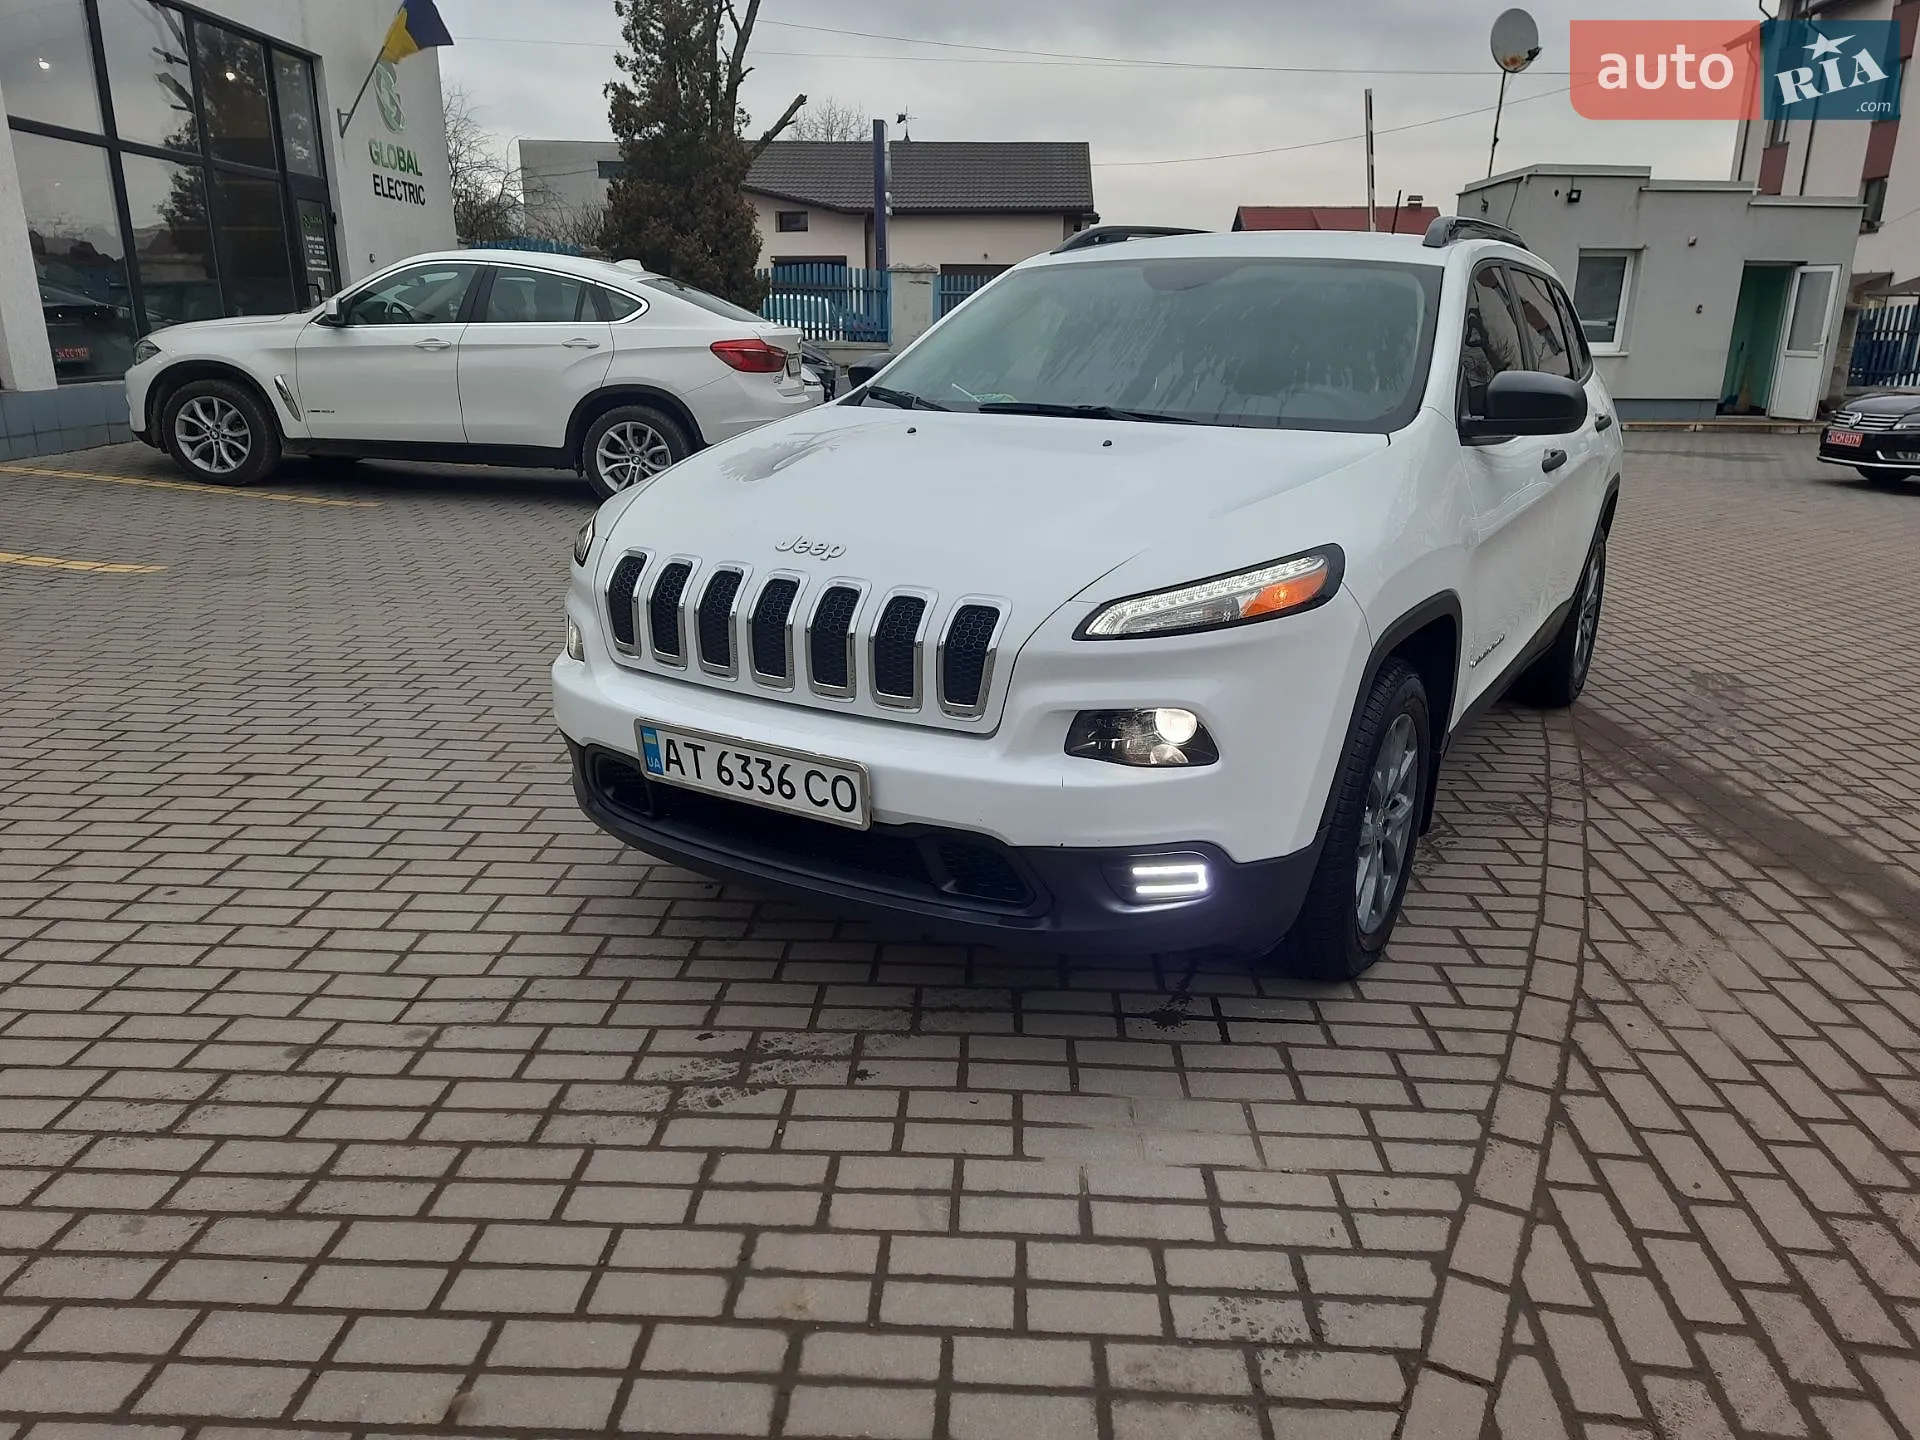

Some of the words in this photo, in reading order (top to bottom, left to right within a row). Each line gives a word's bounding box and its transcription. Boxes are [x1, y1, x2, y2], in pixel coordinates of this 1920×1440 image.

[368, 139, 423, 177] GLOBAL
[372, 173, 426, 206] ELECTRIC
[775, 535, 847, 561] Jeep
[647, 757, 662, 770] UA
[665, 738, 706, 780] AT
[716, 751, 796, 800] 6336
[804, 769, 857, 813] CO
